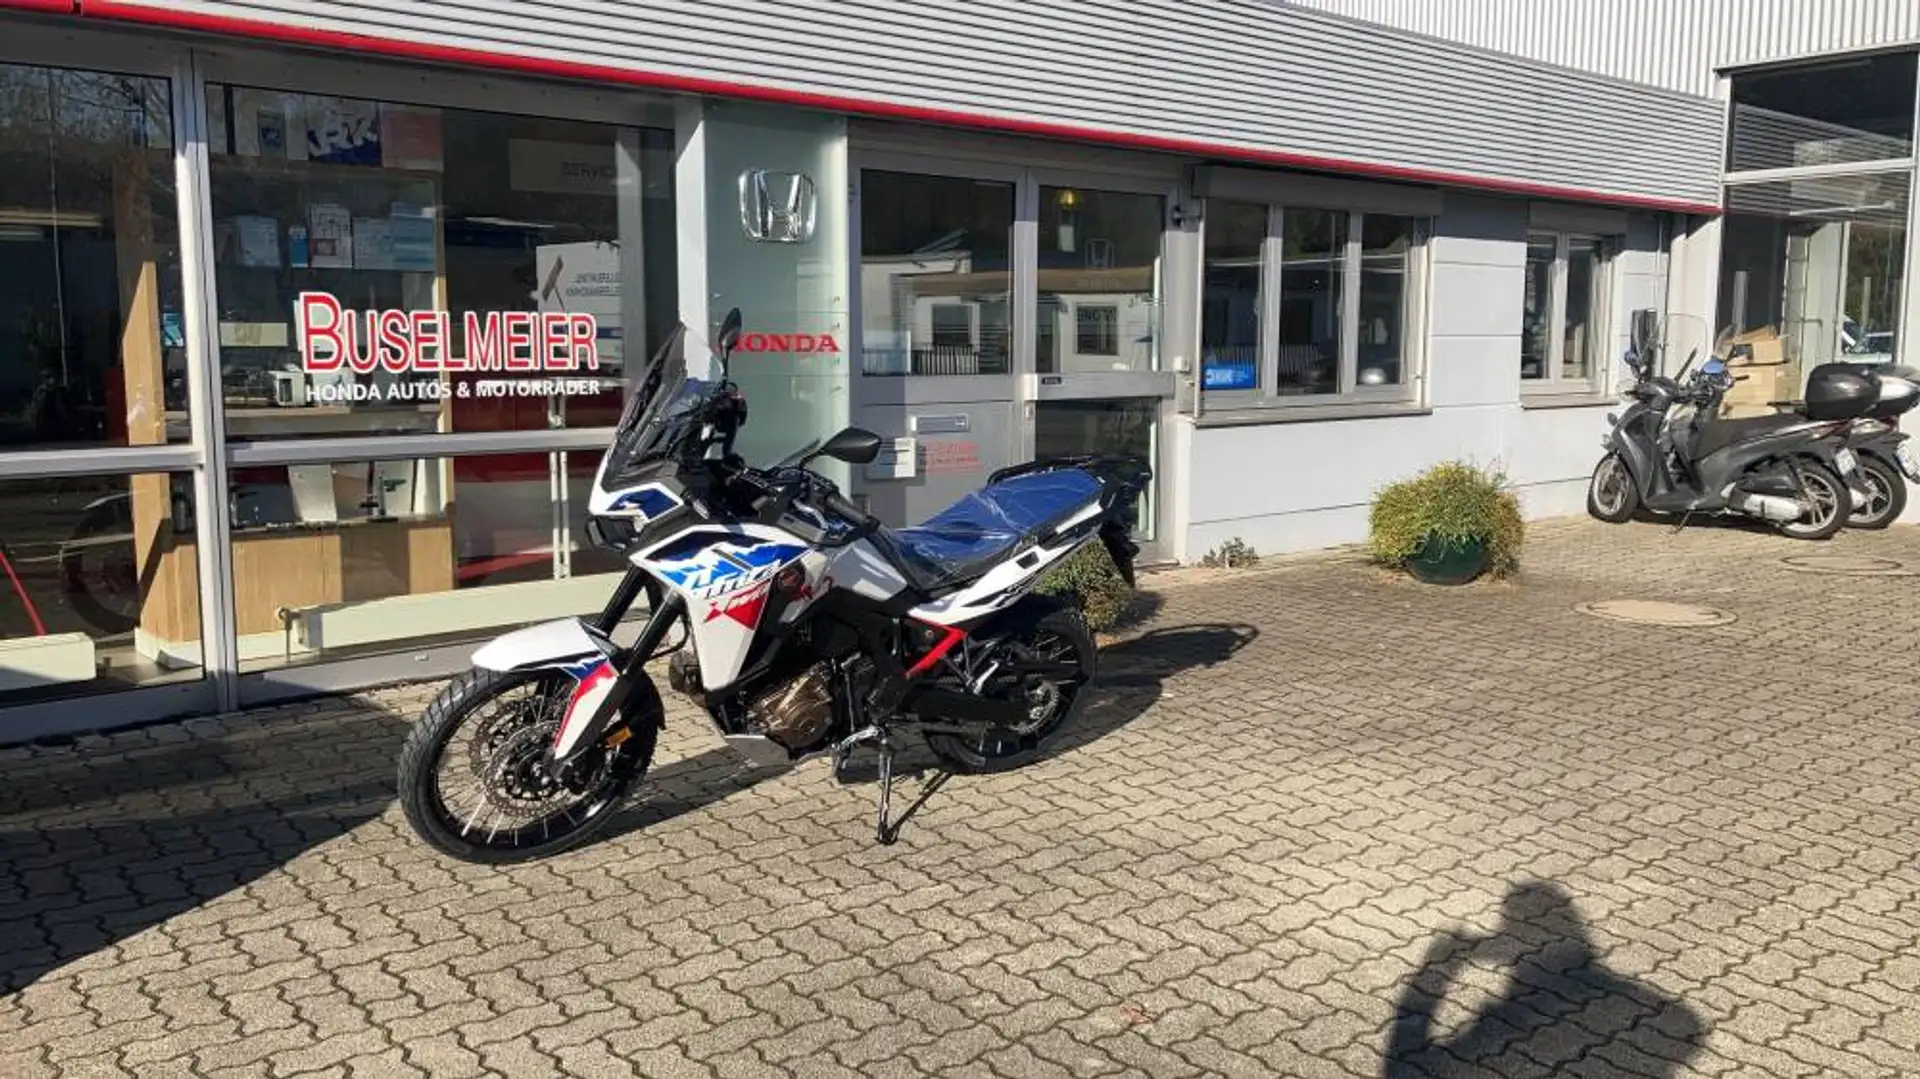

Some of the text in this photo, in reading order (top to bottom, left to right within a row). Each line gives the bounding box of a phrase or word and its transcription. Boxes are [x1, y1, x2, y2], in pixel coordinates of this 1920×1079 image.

[306, 382, 382, 402] HONDA
[386, 380, 453, 400] AUTOS
[456, 381, 471, 398] &
